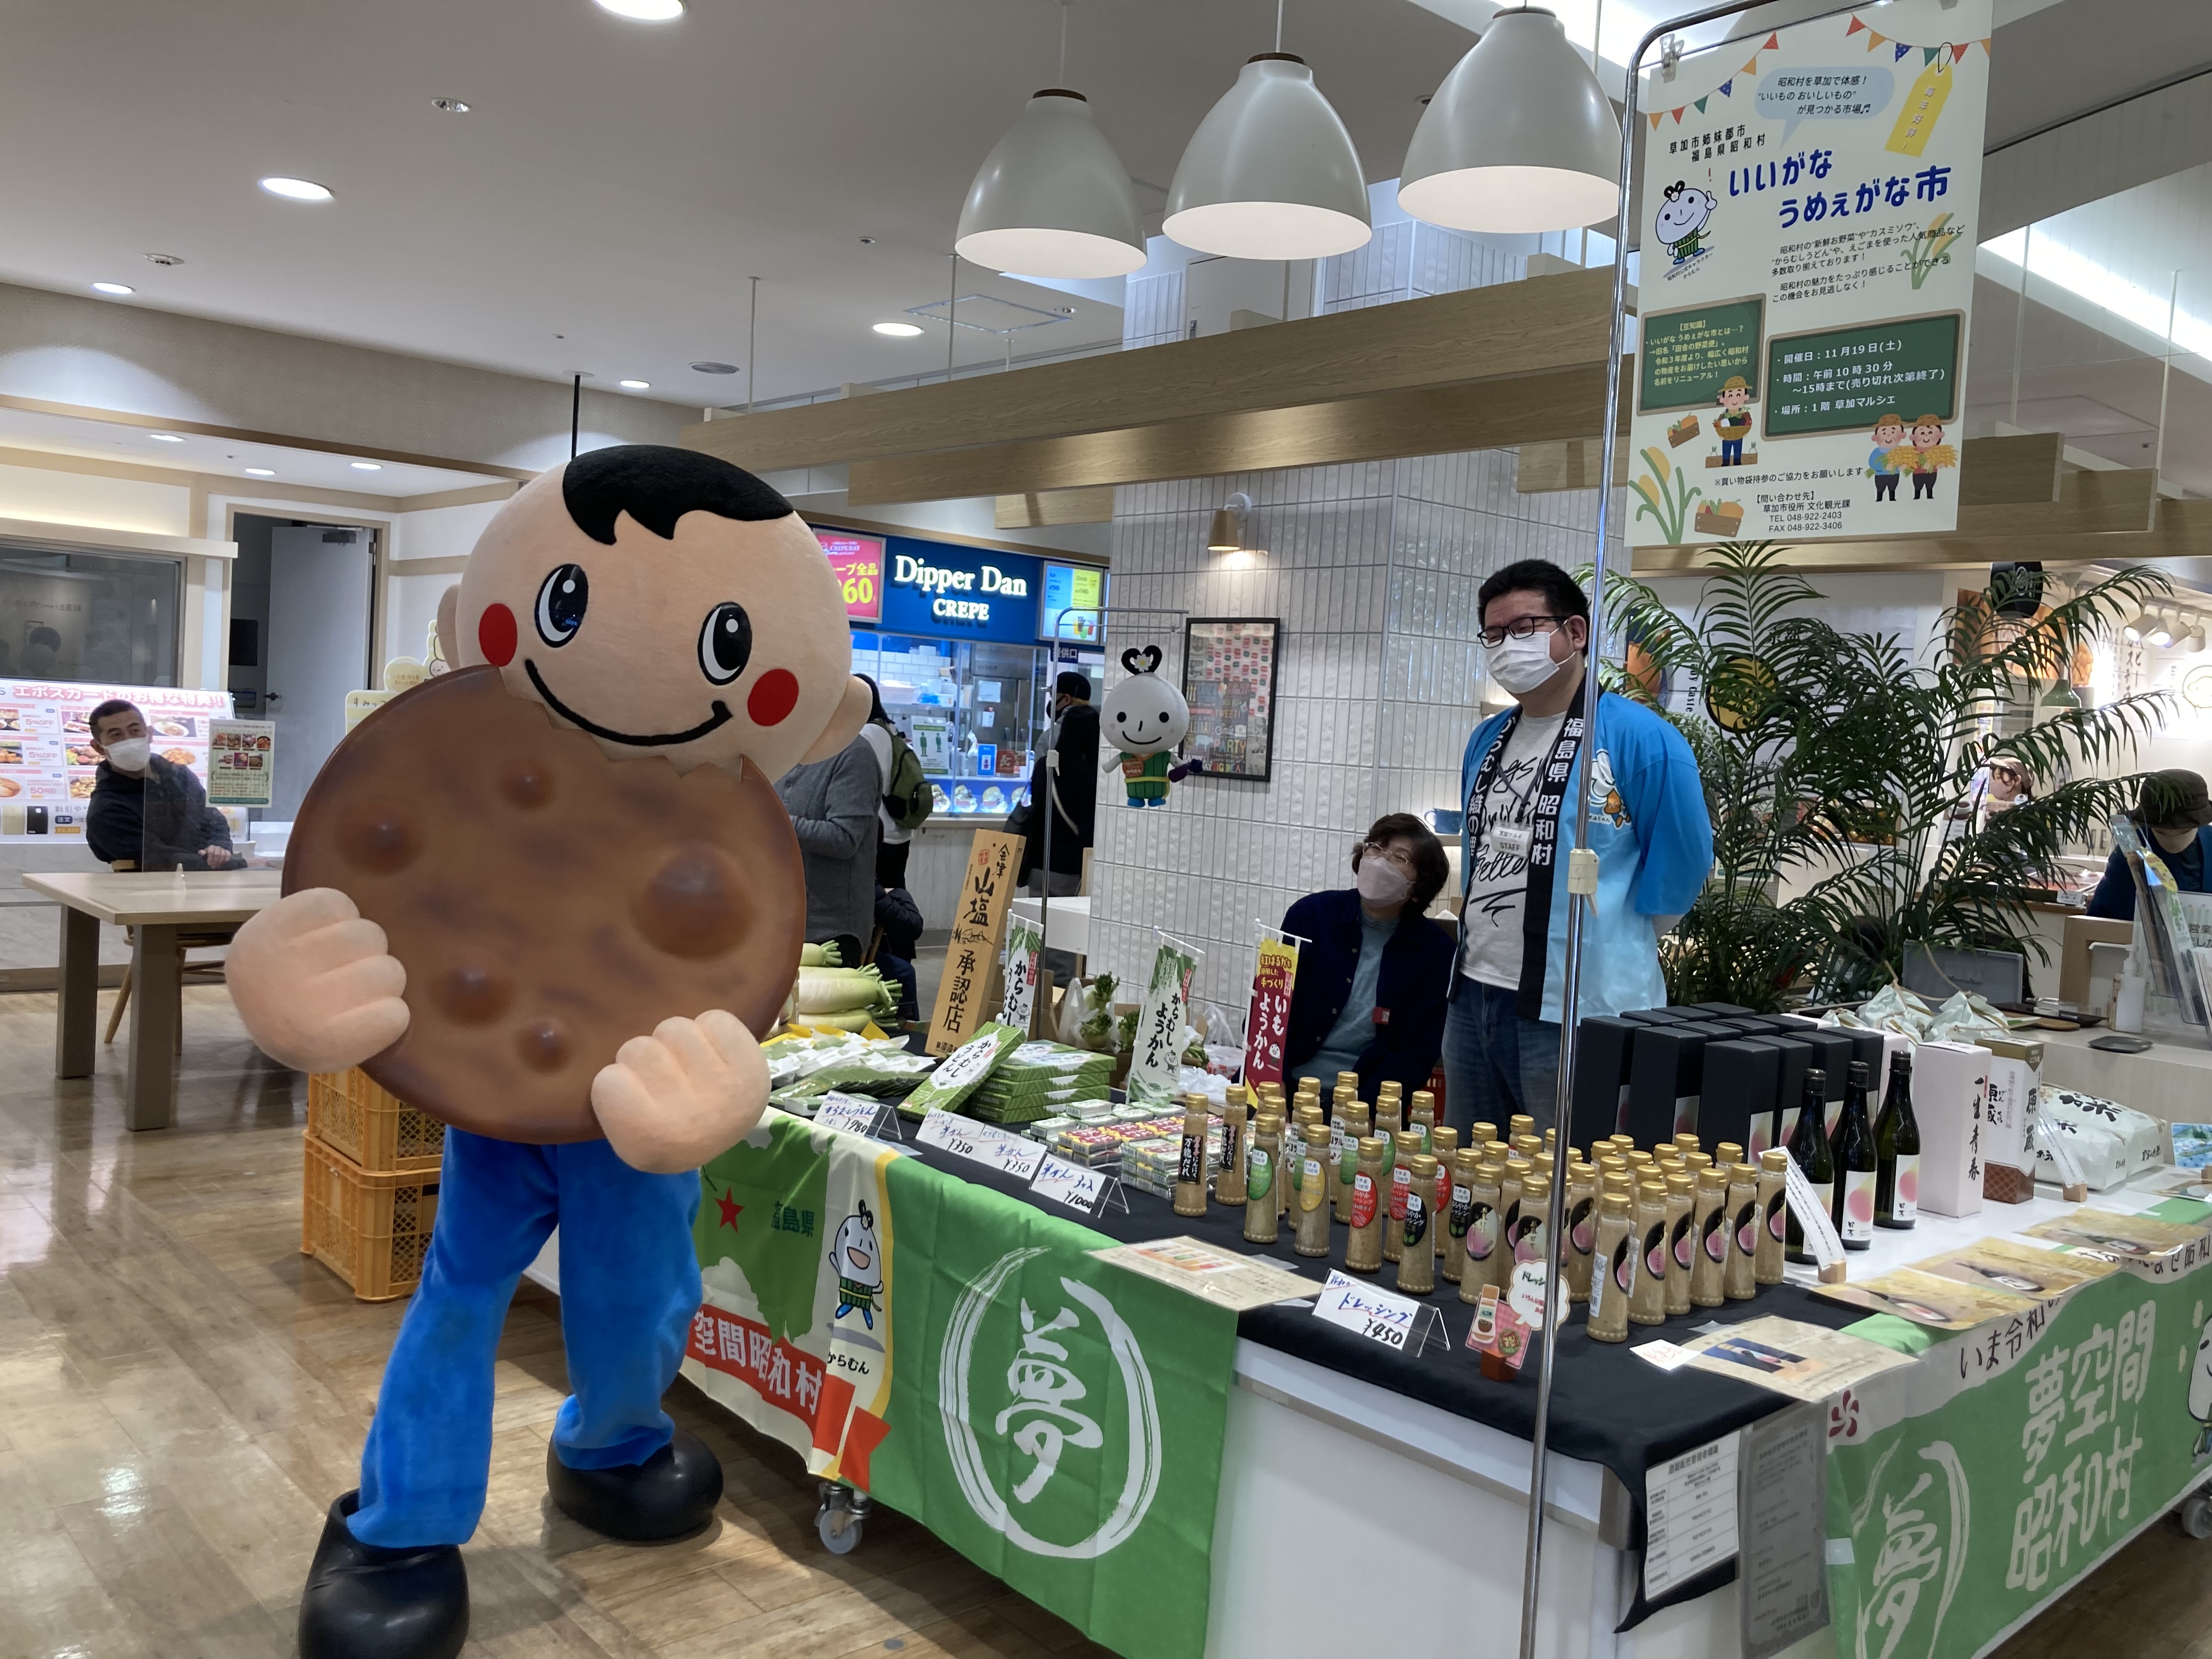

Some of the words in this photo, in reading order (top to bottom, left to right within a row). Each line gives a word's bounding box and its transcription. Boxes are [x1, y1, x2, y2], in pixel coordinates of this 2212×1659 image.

[1778, 76, 1867, 87] 昭和村を草加で体感！
[1669, 124, 1746, 154] 草加市姉妹都市
[1691, 133, 1765, 162] 福島県昭和村
[1729, 149, 1833, 196] いいがな
[1779, 165, 1952, 229] うめぇがな市
[1771, 253, 1865, 276] 多数取り揃えております！
[1780, 256, 1949, 292] 昭和村の魅力をたっぷり感じることができる
[1773, 280, 1866, 302] この機会をお見逃しなく！
[1654, 371, 1718, 386] 名前をリニューアル！
[1655, 357, 1748, 375] の物産をお届けしたい思いから
[1756, 491, 1815, 504] 【問い合わせ先】
[1763, 502, 1804, 513] 草加市役所
[1807, 499, 1850, 511] 文化観光課
[1769, 524, 1785, 533] FAX
[1787, 521, 1842, 532] 048-922-3406
[1787, 511, 1842, 522] 048-922-2403
[833, 562, 878, 575] ープ全品
[894, 554, 975, 592] Dipper
[980, 565, 1028, 597] Dan
[838, 577, 873, 604] 60
[933, 597, 990, 620] CREPE
[1214, 739, 1246, 754] PARTY
[1548, 718, 1584, 782] 福島県
[1499, 830, 1522, 840] 草加マルイ
[1531, 794, 1560, 866] 昭和村
[992, 843, 1010, 879] 会津
[1499, 841, 1520, 851] STAFF
[963, 867, 995, 926] 山塩
[943, 949, 976, 1034] 承認店
[1261, 978, 1284, 988] 手づくり
[1166, 993, 1181, 1046] からむし
[1272, 995, 1287, 1036] いも
[1146, 1002, 1168, 1068] ようかん
[1253, 992, 1271, 1070] ようかん
[943, 1045, 974, 1073] うどん
[950, 1040, 991, 1077] からむし
[1182, 1138, 1193, 1177] 万能だれ
[1339, 1293, 1413, 1324] ドレッシング
[995, 1296, 1103, 1504] 夢
[2022, 1299, 2156, 1485] 夢空間
[2006, 1412, 2143, 1591] 昭和村
